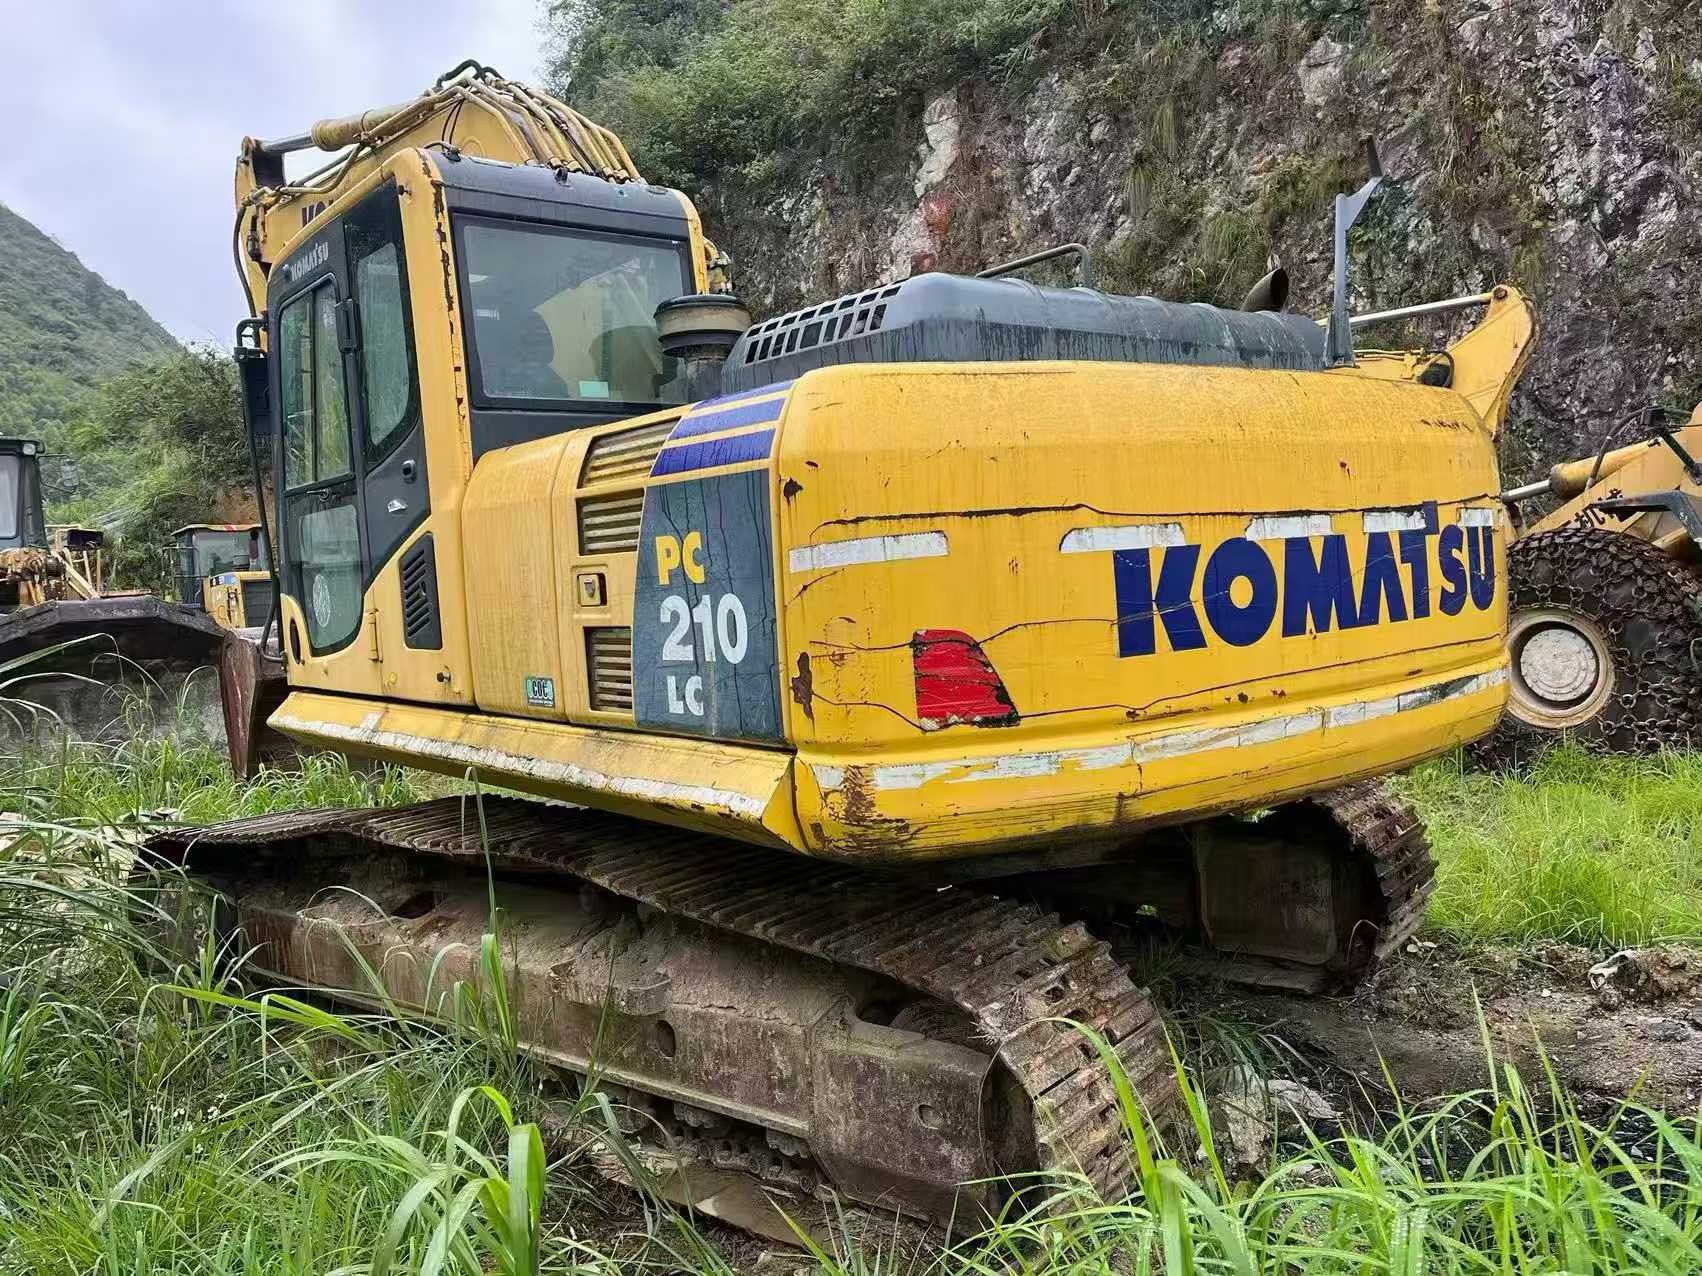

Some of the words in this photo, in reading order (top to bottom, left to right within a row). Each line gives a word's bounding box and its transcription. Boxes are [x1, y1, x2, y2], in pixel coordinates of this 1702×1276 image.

[291, 242, 329, 281] KOMATSU
[655, 531, 705, 585] PC
[1113, 501, 1496, 658] KOMATSU
[660, 593, 748, 664] 210
[666, 675, 704, 716] LC
